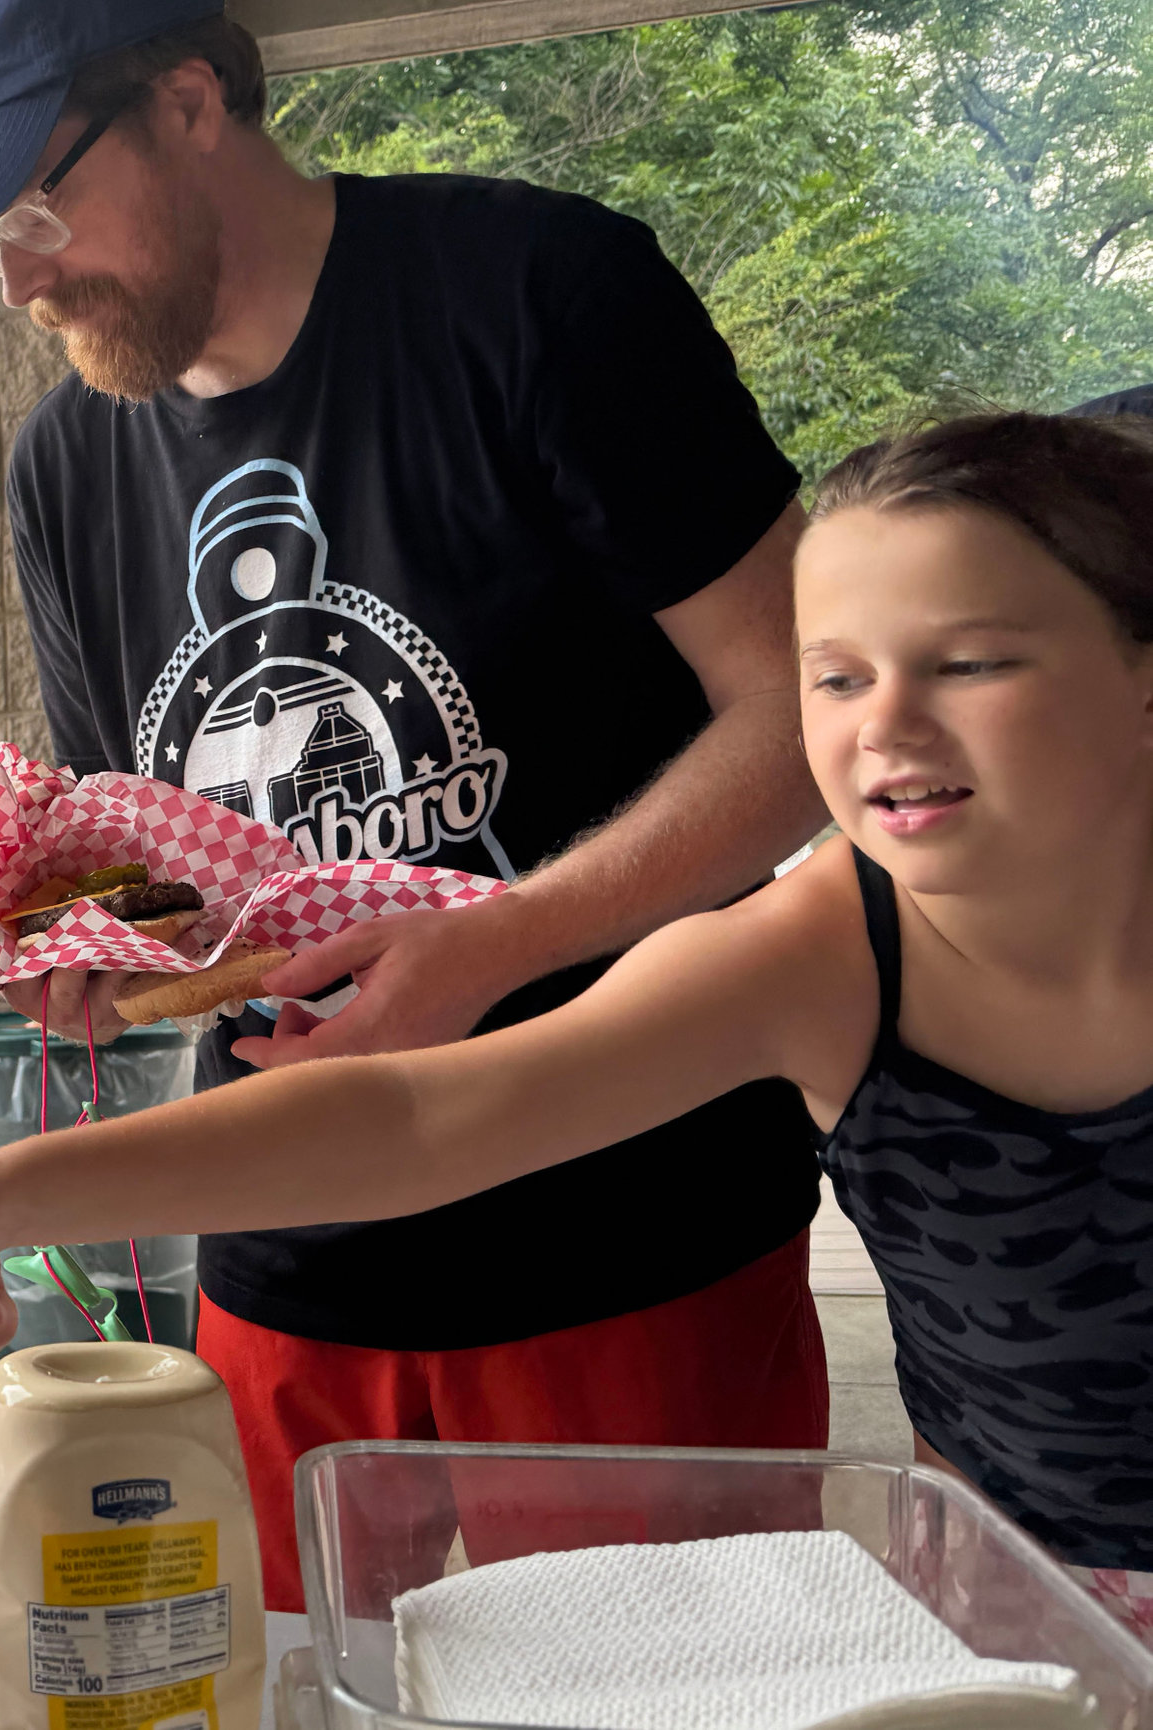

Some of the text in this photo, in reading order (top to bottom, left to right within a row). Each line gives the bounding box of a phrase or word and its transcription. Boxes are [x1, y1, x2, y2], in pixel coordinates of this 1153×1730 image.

[97, 1485, 165, 1507] HELLMANN'S
[62, 1549, 79, 1559] FOR
[81, 1545, 104, 1557] OVER
[54, 1562, 72, 1572] HAS
[74, 1560, 96, 1572] BEEN
[98, 1555, 148, 1569] COMMITTED
[150, 1553, 161, 1563] TO
[94, 1568, 148, 1583] INGREDIENTS
[151, 1567, 161, 1577] TO
[71, 1584, 109, 1596] HIGHEST
[110, 1581, 144, 1594] QUALITY
[32, 1607, 89, 1622] Nutrition
[33, 1621, 67, 1634] Facts
[35, 1654, 66, 1664] Serving
[35, 1675, 102, 1692] Calories 100
